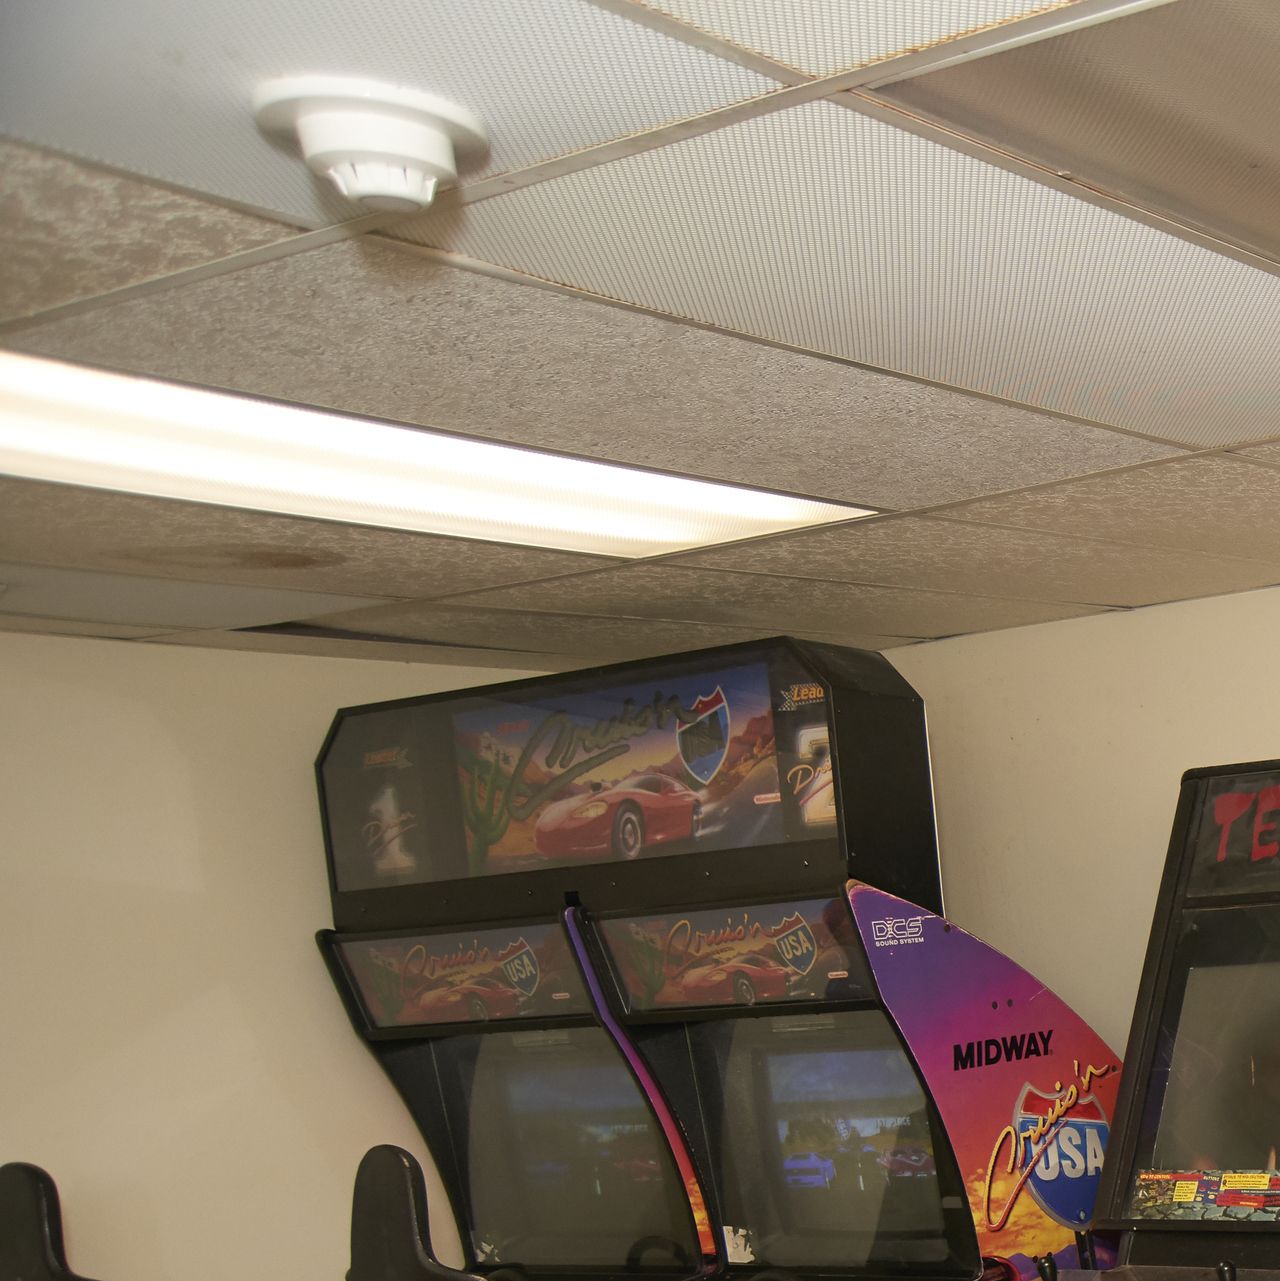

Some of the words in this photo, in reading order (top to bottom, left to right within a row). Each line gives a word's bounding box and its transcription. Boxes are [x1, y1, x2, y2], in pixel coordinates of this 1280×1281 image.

[872, 917, 923, 942] DCS
[875, 938, 898, 947] SOUND
[899, 936, 925, 946] SYSTEM
[780, 933, 811, 961] USA
[506, 955, 536, 984] USA
[953, 1029, 1054, 1071] MIDWAY
[983, 1060, 1111, 1232] Cruis'n
[1034, 1127, 1108, 1182] USA
